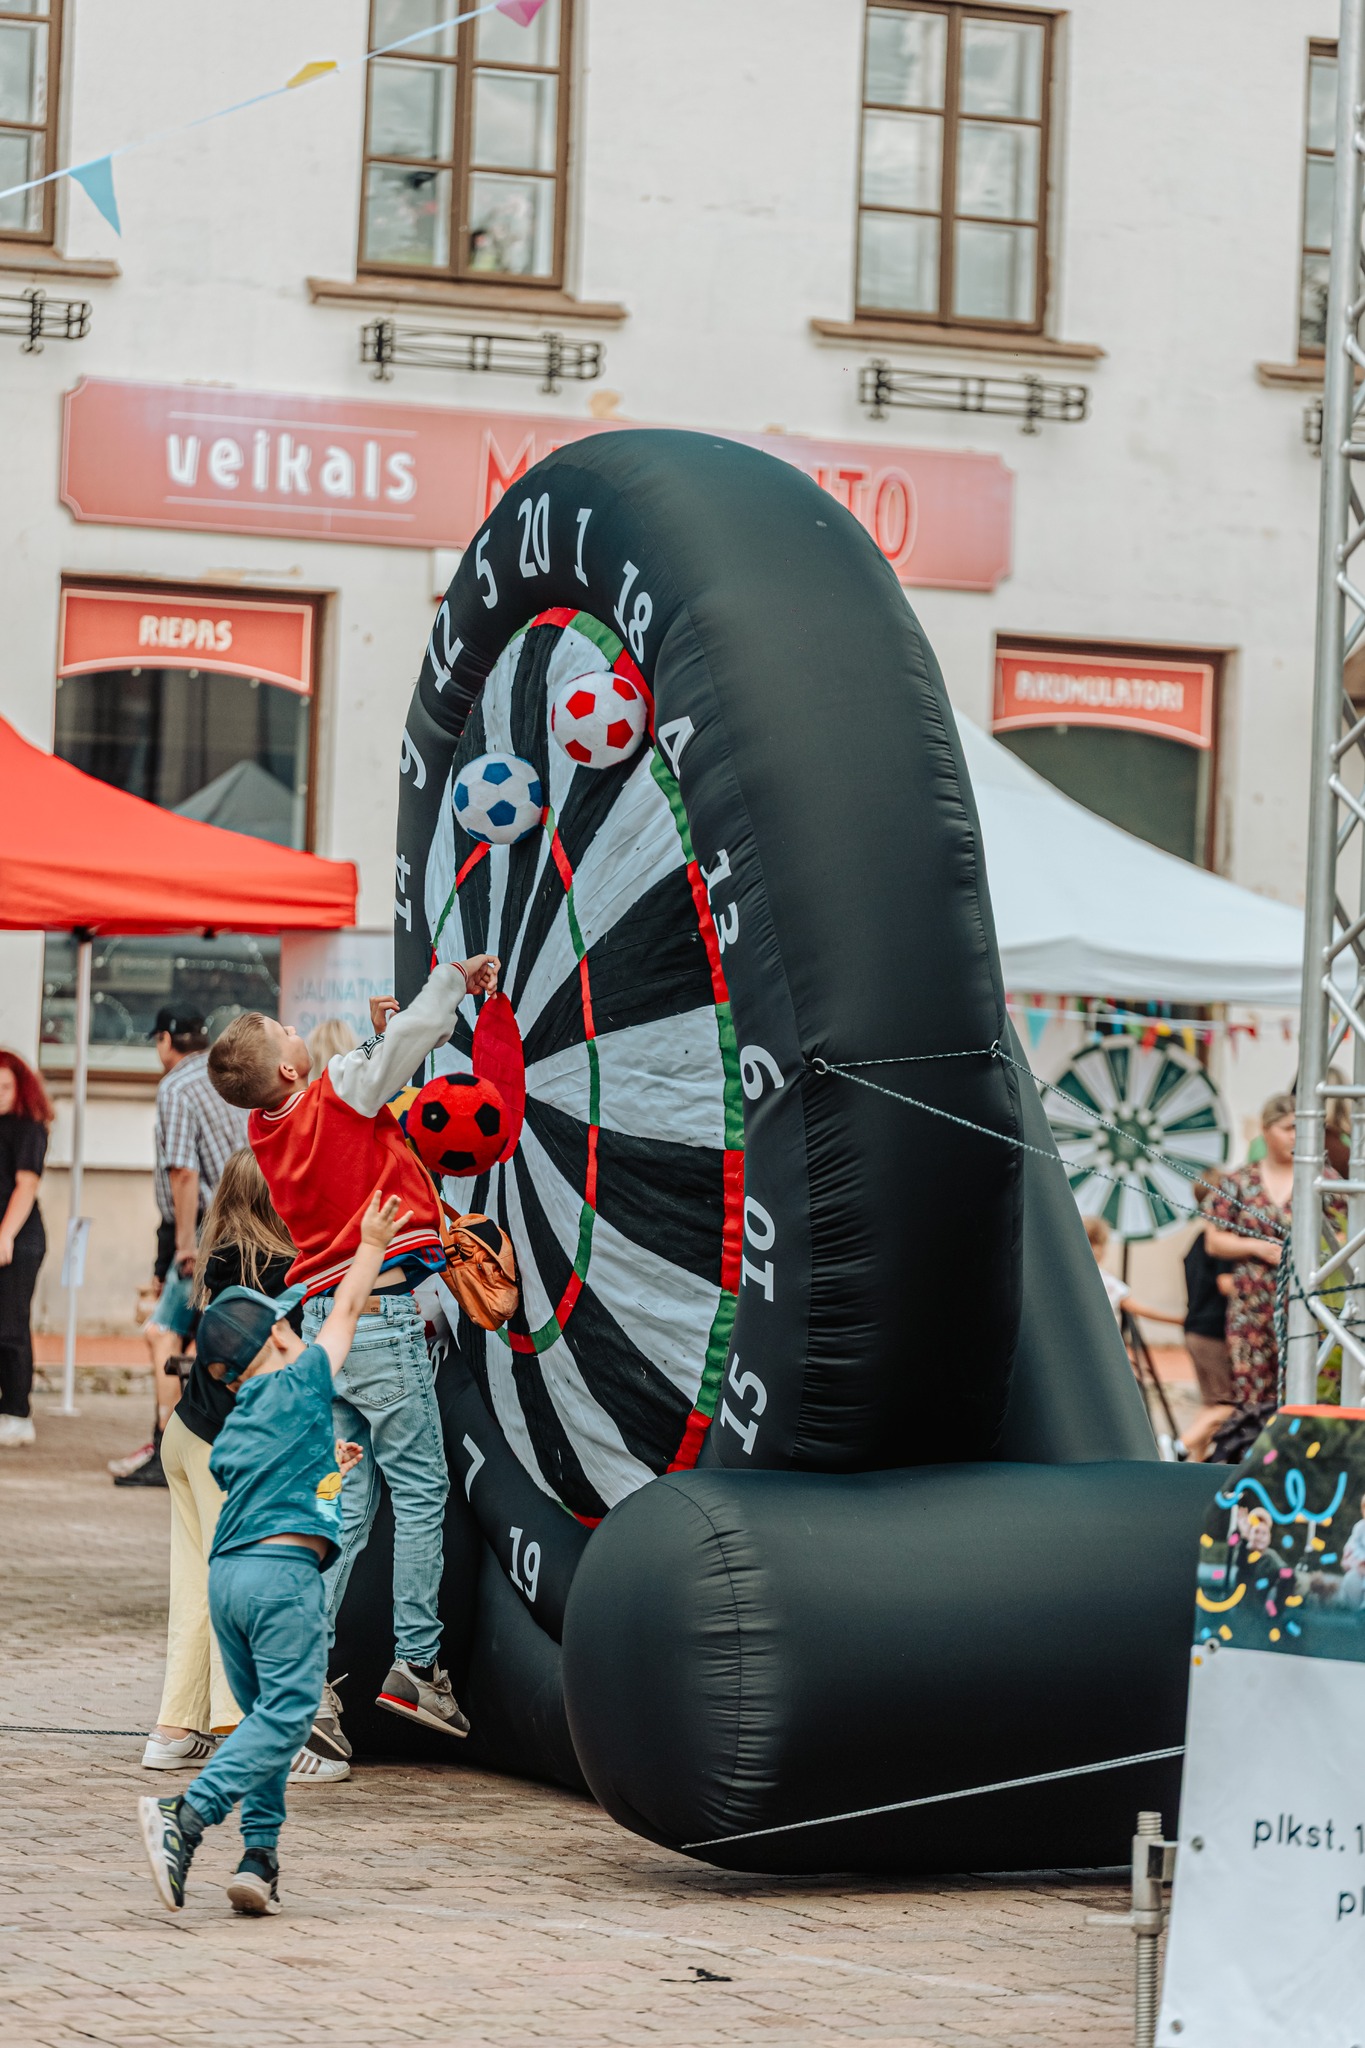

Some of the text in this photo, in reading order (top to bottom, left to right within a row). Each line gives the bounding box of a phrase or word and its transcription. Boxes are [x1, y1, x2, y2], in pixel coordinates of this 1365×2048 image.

[167, 429, 417, 502] veikals
[475, 528, 499, 609] 5
[517, 492, 551, 578] 20
[574, 507, 593, 587] 1
[138, 614, 233, 652] RIEPAS
[425, 600, 466, 694] 12
[613, 560, 654, 664] 18
[400, 726, 427, 790] 9
[700, 848, 740, 954] 13
[741, 1195, 776, 1303] 10
[719, 1352, 768, 1456] 15
[462, 1433, 486, 1503] 7
[508, 1526, 542, 1602] 19
